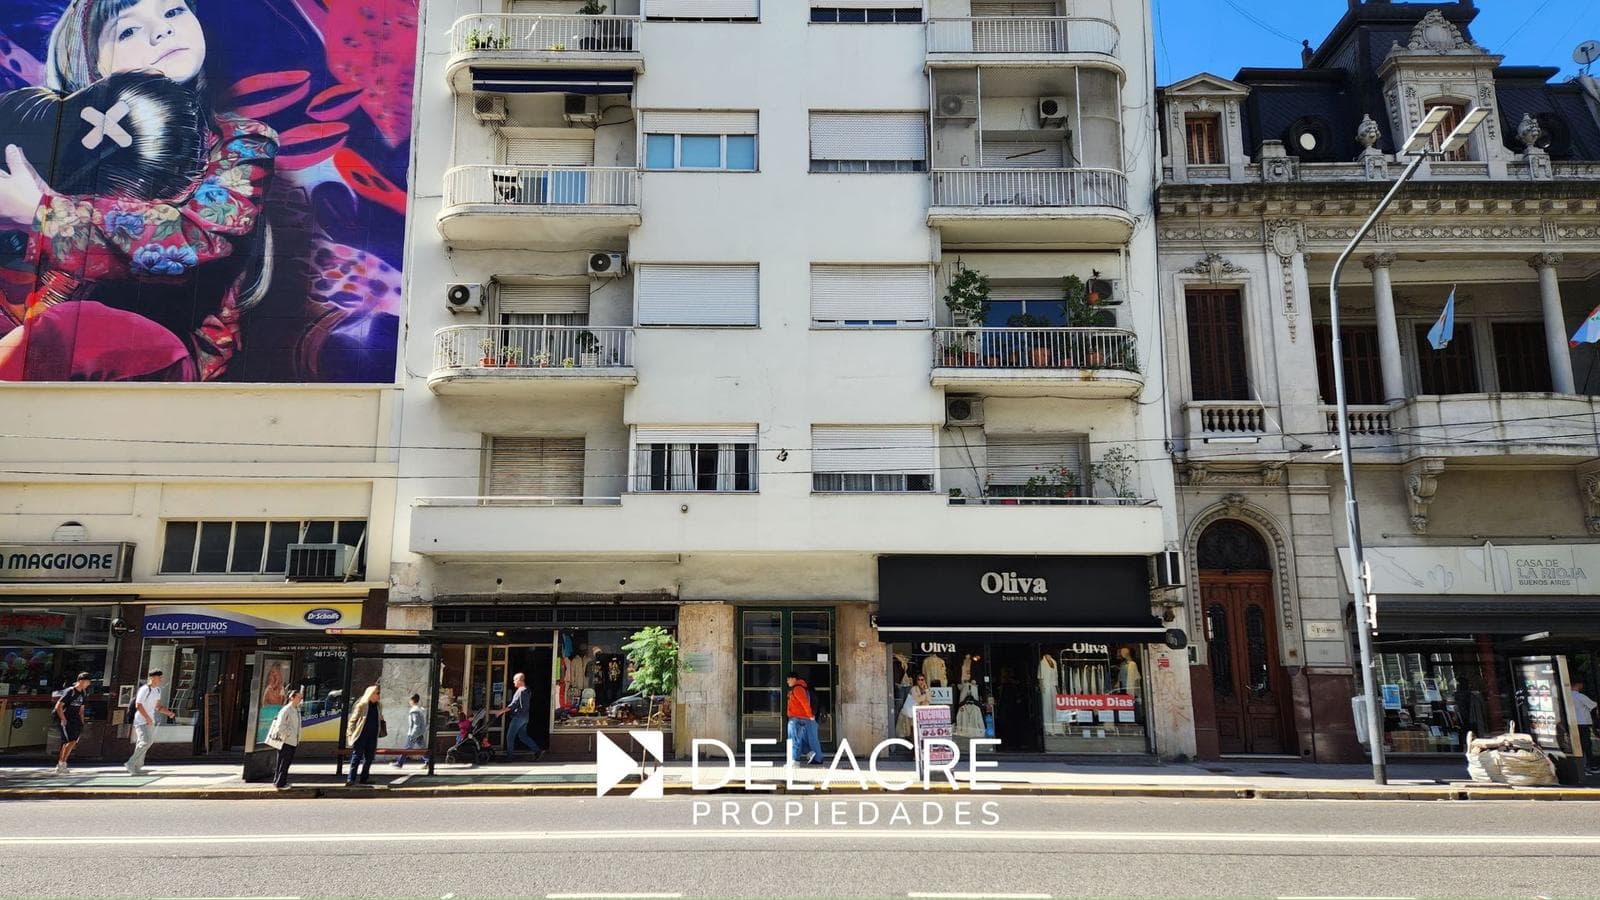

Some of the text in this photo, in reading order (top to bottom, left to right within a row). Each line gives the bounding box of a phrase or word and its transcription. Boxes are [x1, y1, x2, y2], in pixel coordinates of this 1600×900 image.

[8, 553, 113, 569] MAGGIORE
[1516, 559, 1559, 568] CASA DE
[1517, 567, 1588, 579] LA RIOJA
[981, 571, 1048, 594] Oliva
[145, 621, 228, 631] CALLAO PEDICUROS
[1056, 697, 1103, 706] Ultimos
